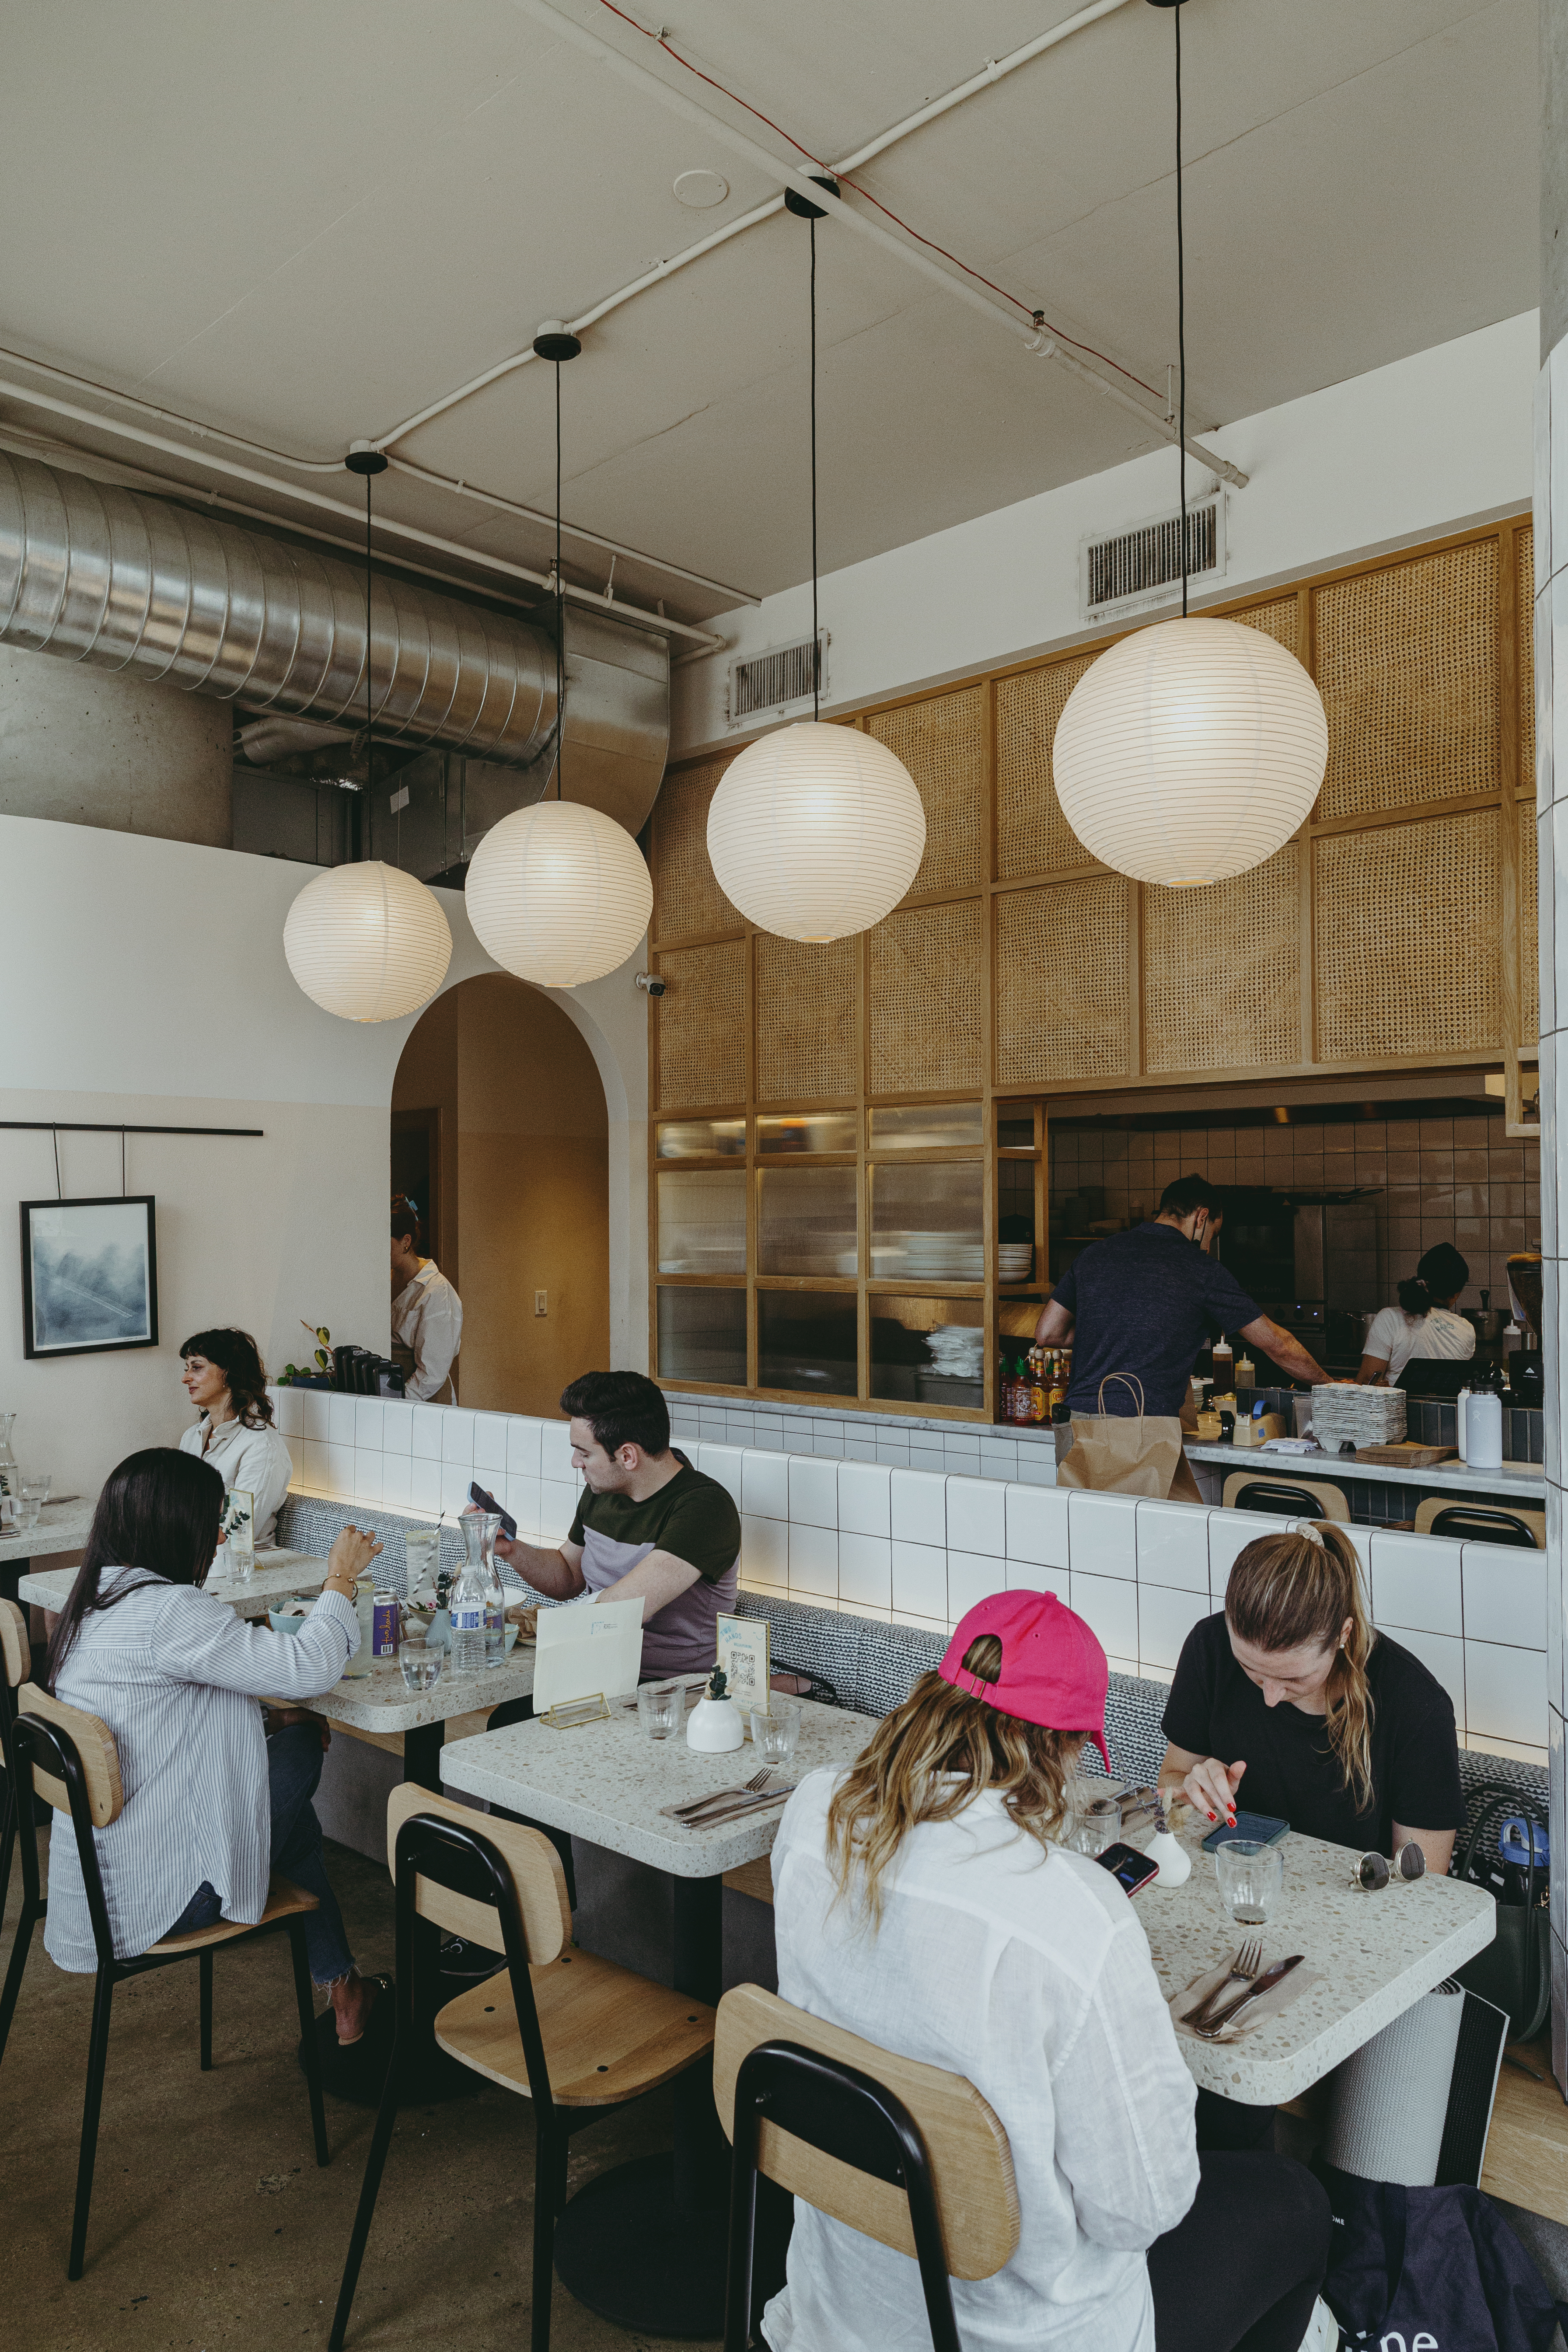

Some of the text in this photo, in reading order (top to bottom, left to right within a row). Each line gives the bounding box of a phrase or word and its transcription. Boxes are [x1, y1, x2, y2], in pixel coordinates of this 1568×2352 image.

[379, 1609, 393, 1644] two hands
[719, 1626, 732, 1637] TWO
[724, 1633, 742, 1644] HANDS
